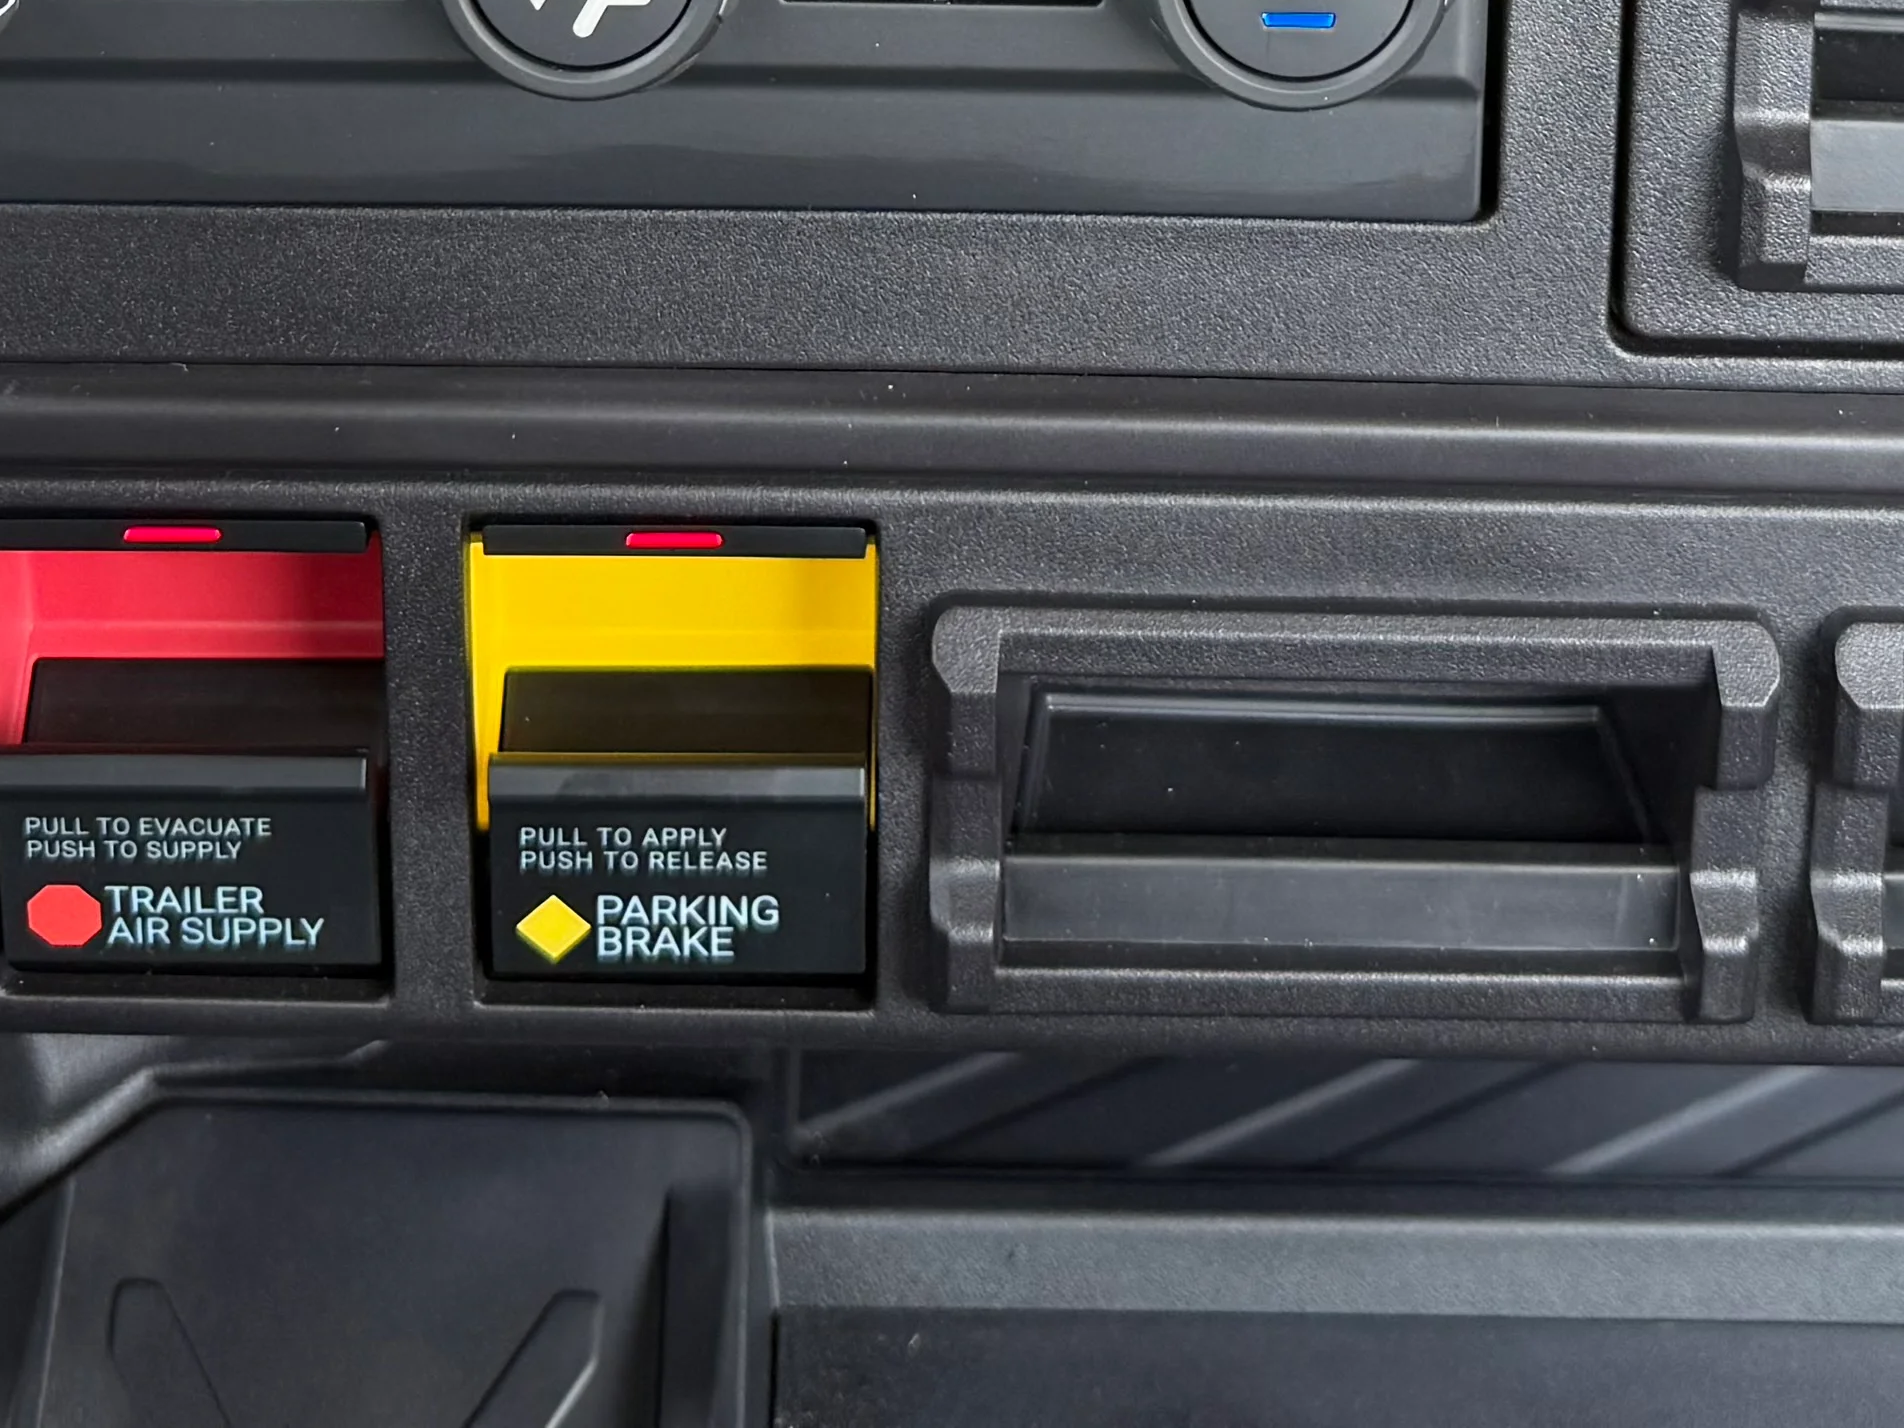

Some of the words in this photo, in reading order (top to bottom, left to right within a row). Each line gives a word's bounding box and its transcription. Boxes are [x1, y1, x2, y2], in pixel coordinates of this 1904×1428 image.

[25, 816, 90, 836] PULL
[97, 817, 131, 836] TO
[139, 817, 272, 837] EVACUATE
[519, 827, 588, 847] PULL
[597, 827, 632, 847] TO
[642, 827, 727, 847] APPLY
[27, 840, 96, 860] PUSH
[104, 841, 138, 860] TO
[147, 841, 242, 861] SUPPLY
[520, 851, 594, 871] PUSH
[604, 851, 639, 871] TO
[649, 851, 769, 871] RELEASE
[104, 885, 265, 915] TRAILER
[596, 895, 780, 927] PARKING
[107, 916, 171, 946] AIR
[181, 917, 325, 947] SUPPLY
[597, 926, 735, 958] BRAKE
